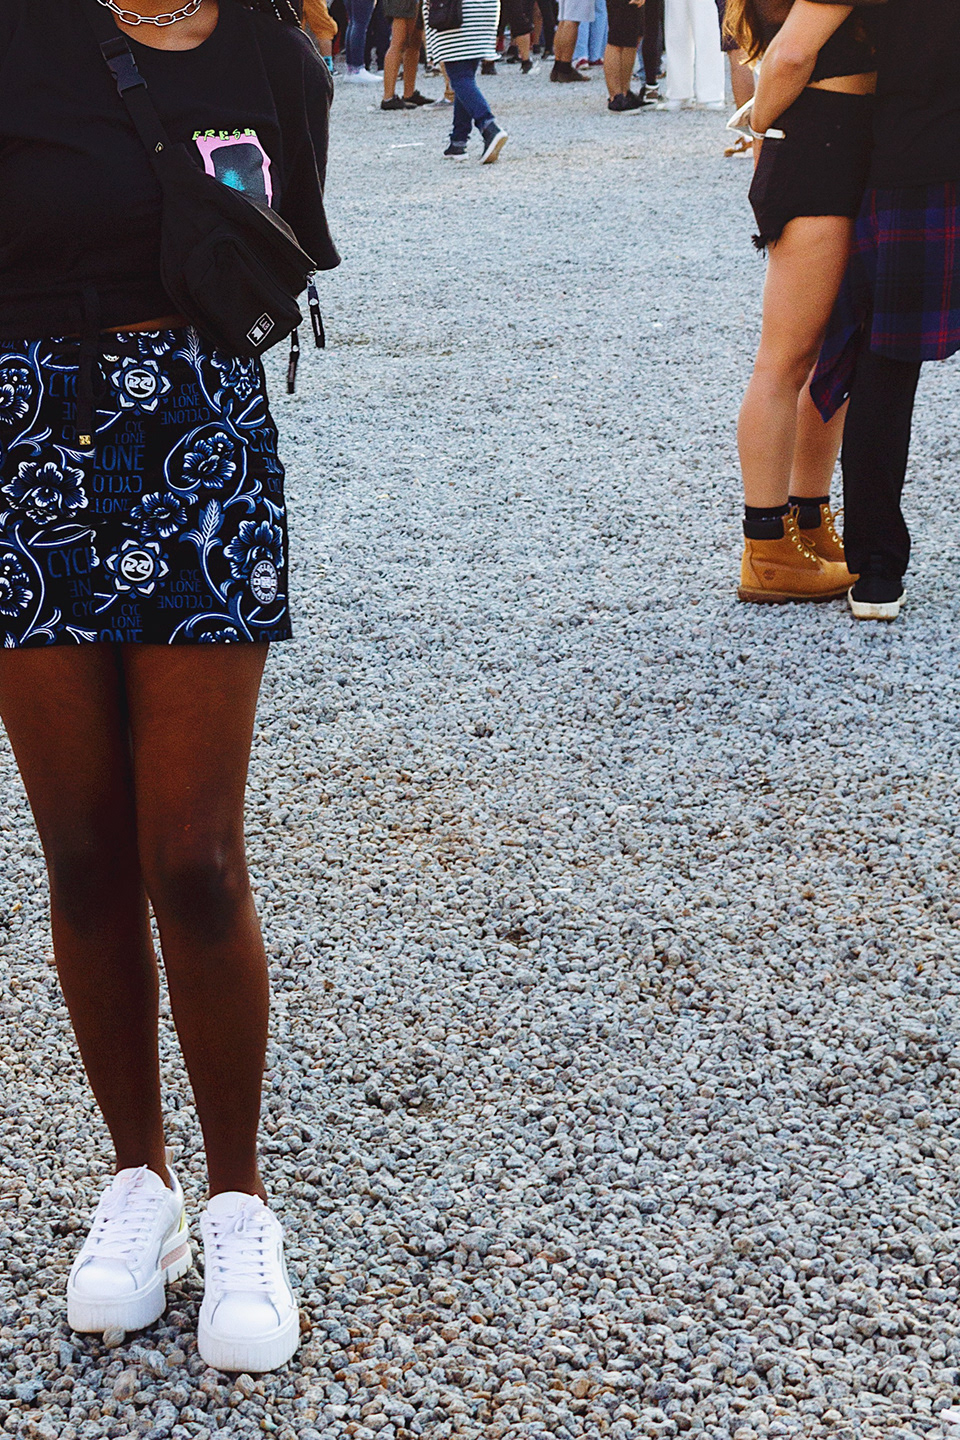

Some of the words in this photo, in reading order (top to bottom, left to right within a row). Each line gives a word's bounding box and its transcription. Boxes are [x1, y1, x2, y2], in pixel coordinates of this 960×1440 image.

[180, 383, 200, 395] CYC
[173, 395, 201, 408] LONE
[160, 407, 211, 425] CYCLONE
[124, 421, 145, 433] CYC
[115, 432, 146, 445] LONE
[93, 444, 145, 471] LONE
[180, 569, 201, 581] CYC
[170, 580, 202, 593] LONE
[156, 595, 213, 609] CYCLONE
[121, 604, 141, 617] CYC
[111, 615, 142, 629] LONE
